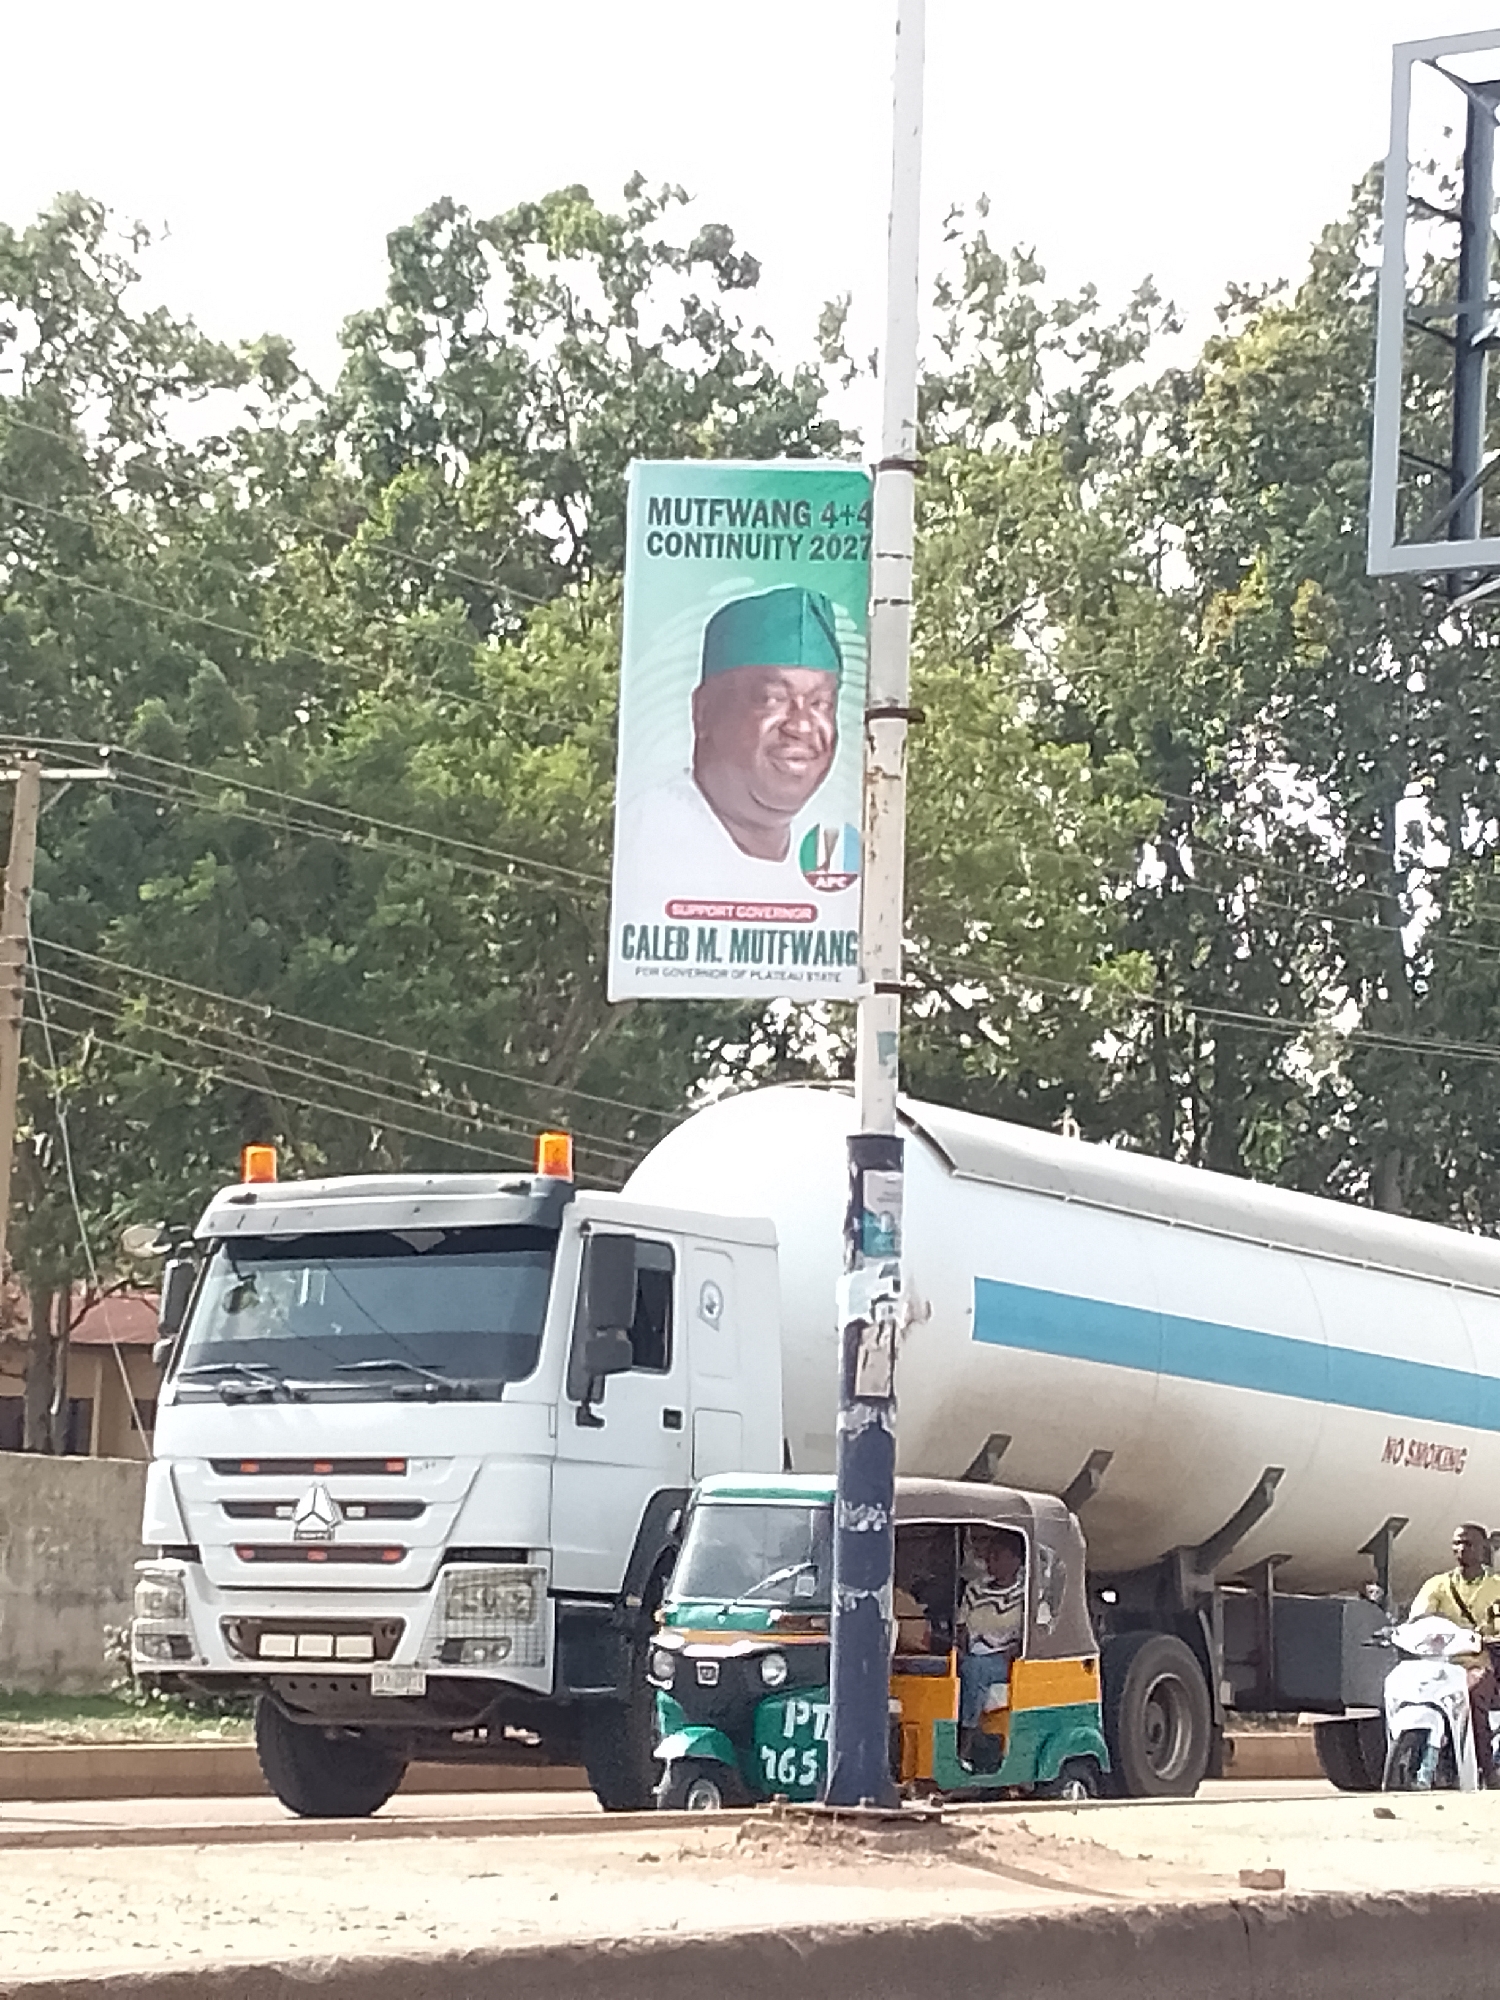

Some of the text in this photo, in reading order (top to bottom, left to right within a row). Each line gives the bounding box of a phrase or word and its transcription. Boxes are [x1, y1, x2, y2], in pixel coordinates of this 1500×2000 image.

[648, 498, 872, 529] MUTFWANG 4+4
[647, 532, 871, 561] CONTINUITY 2027
[815, 876, 847, 888] APC
[671, 903, 812, 920] SUPPORT GOVERNOR
[621, 924, 858, 967] CALEB M. MUTFWANG
[635, 967, 659, 976] FOR
[662, 968, 728, 979] GOVERNOR
[731, 970, 747, 980] OF
[1381, 1436, 1405, 1464] NO
